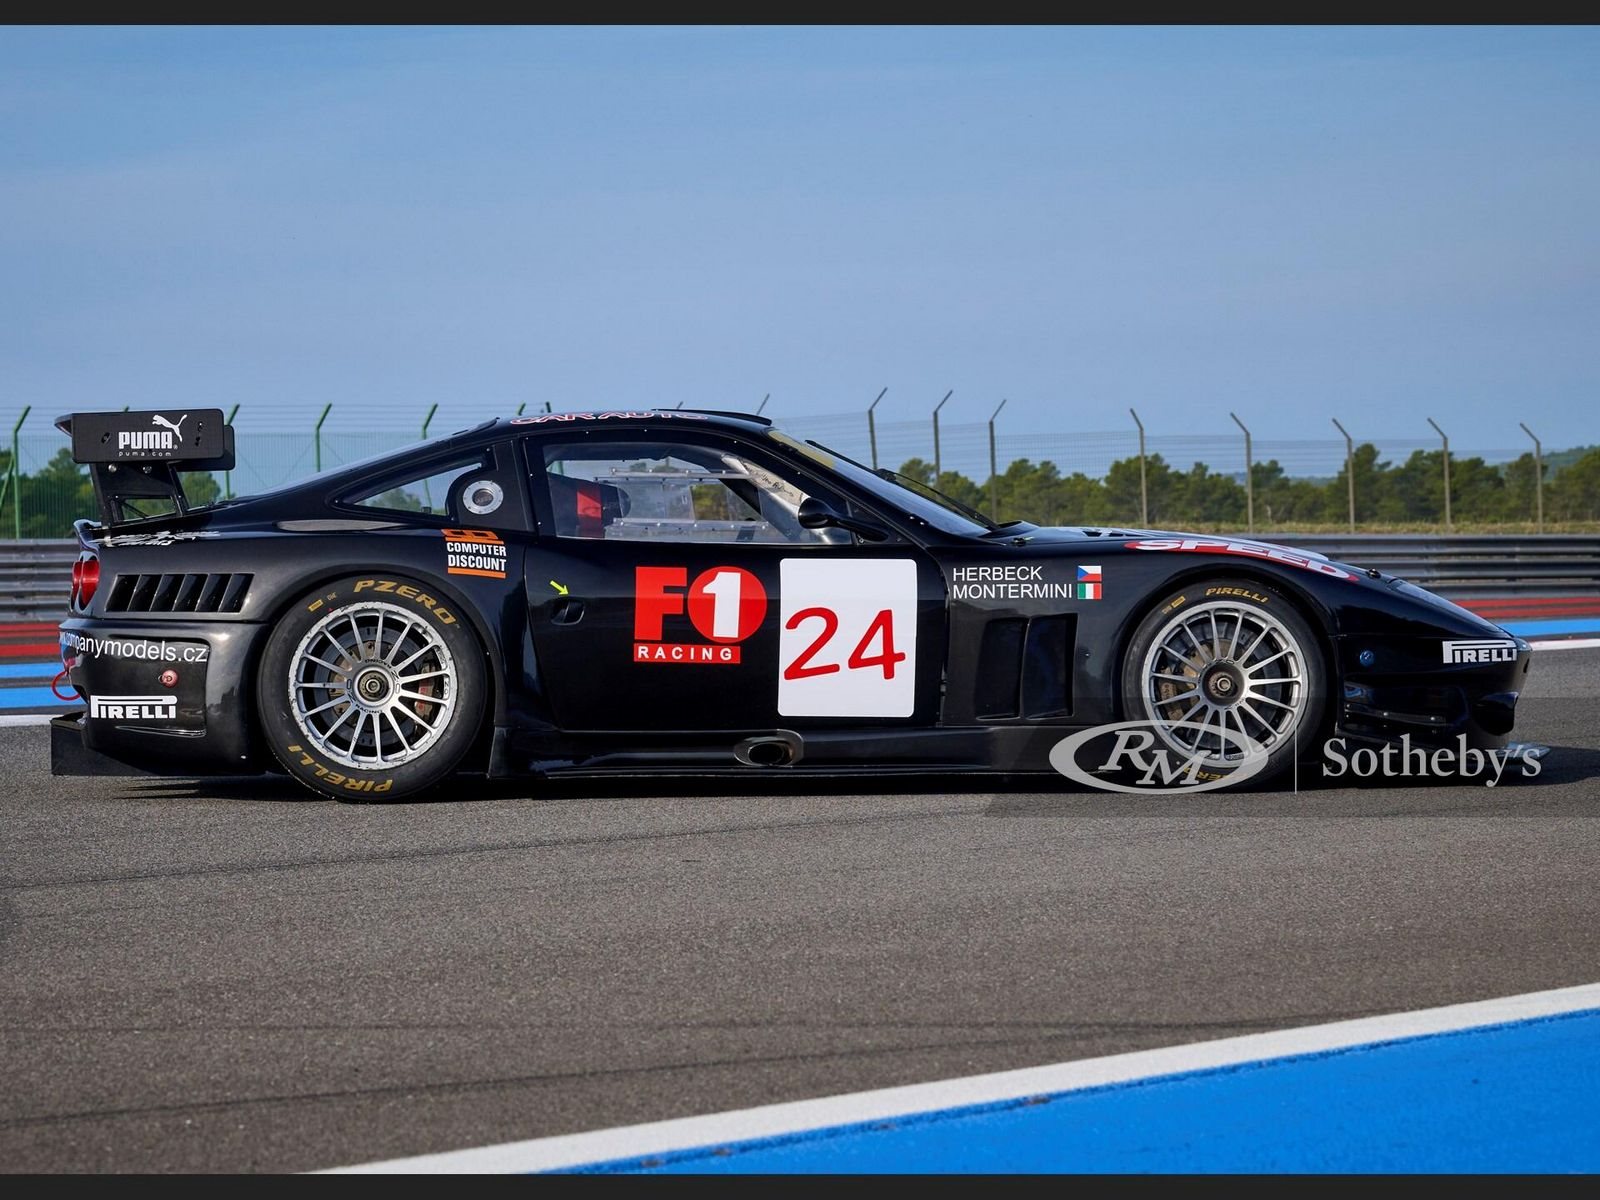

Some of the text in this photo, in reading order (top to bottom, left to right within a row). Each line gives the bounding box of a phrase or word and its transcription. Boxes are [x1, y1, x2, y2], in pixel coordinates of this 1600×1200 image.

[118, 431, 173, 449] PUMA
[446, 542, 507, 557] COMPUTER
[1135, 540, 1350, 579] SPEED
[447, 554, 507, 572] DISCOUNT
[953, 566, 1043, 582] HERBECK
[953, 583, 1073, 599] MONTERMINI
[1205, 587, 1269, 603] PIRELLI
[353, 579, 458, 625] PZERO
[634, 566, 744, 642] F1
[638, 645, 733, 661] RACING
[784, 607, 906, 680] 24
[1442, 640, 1518, 664] PIRELLI
[90, 695, 178, 719] PIRELLI
[287, 745, 393, 793] PIRELLI
